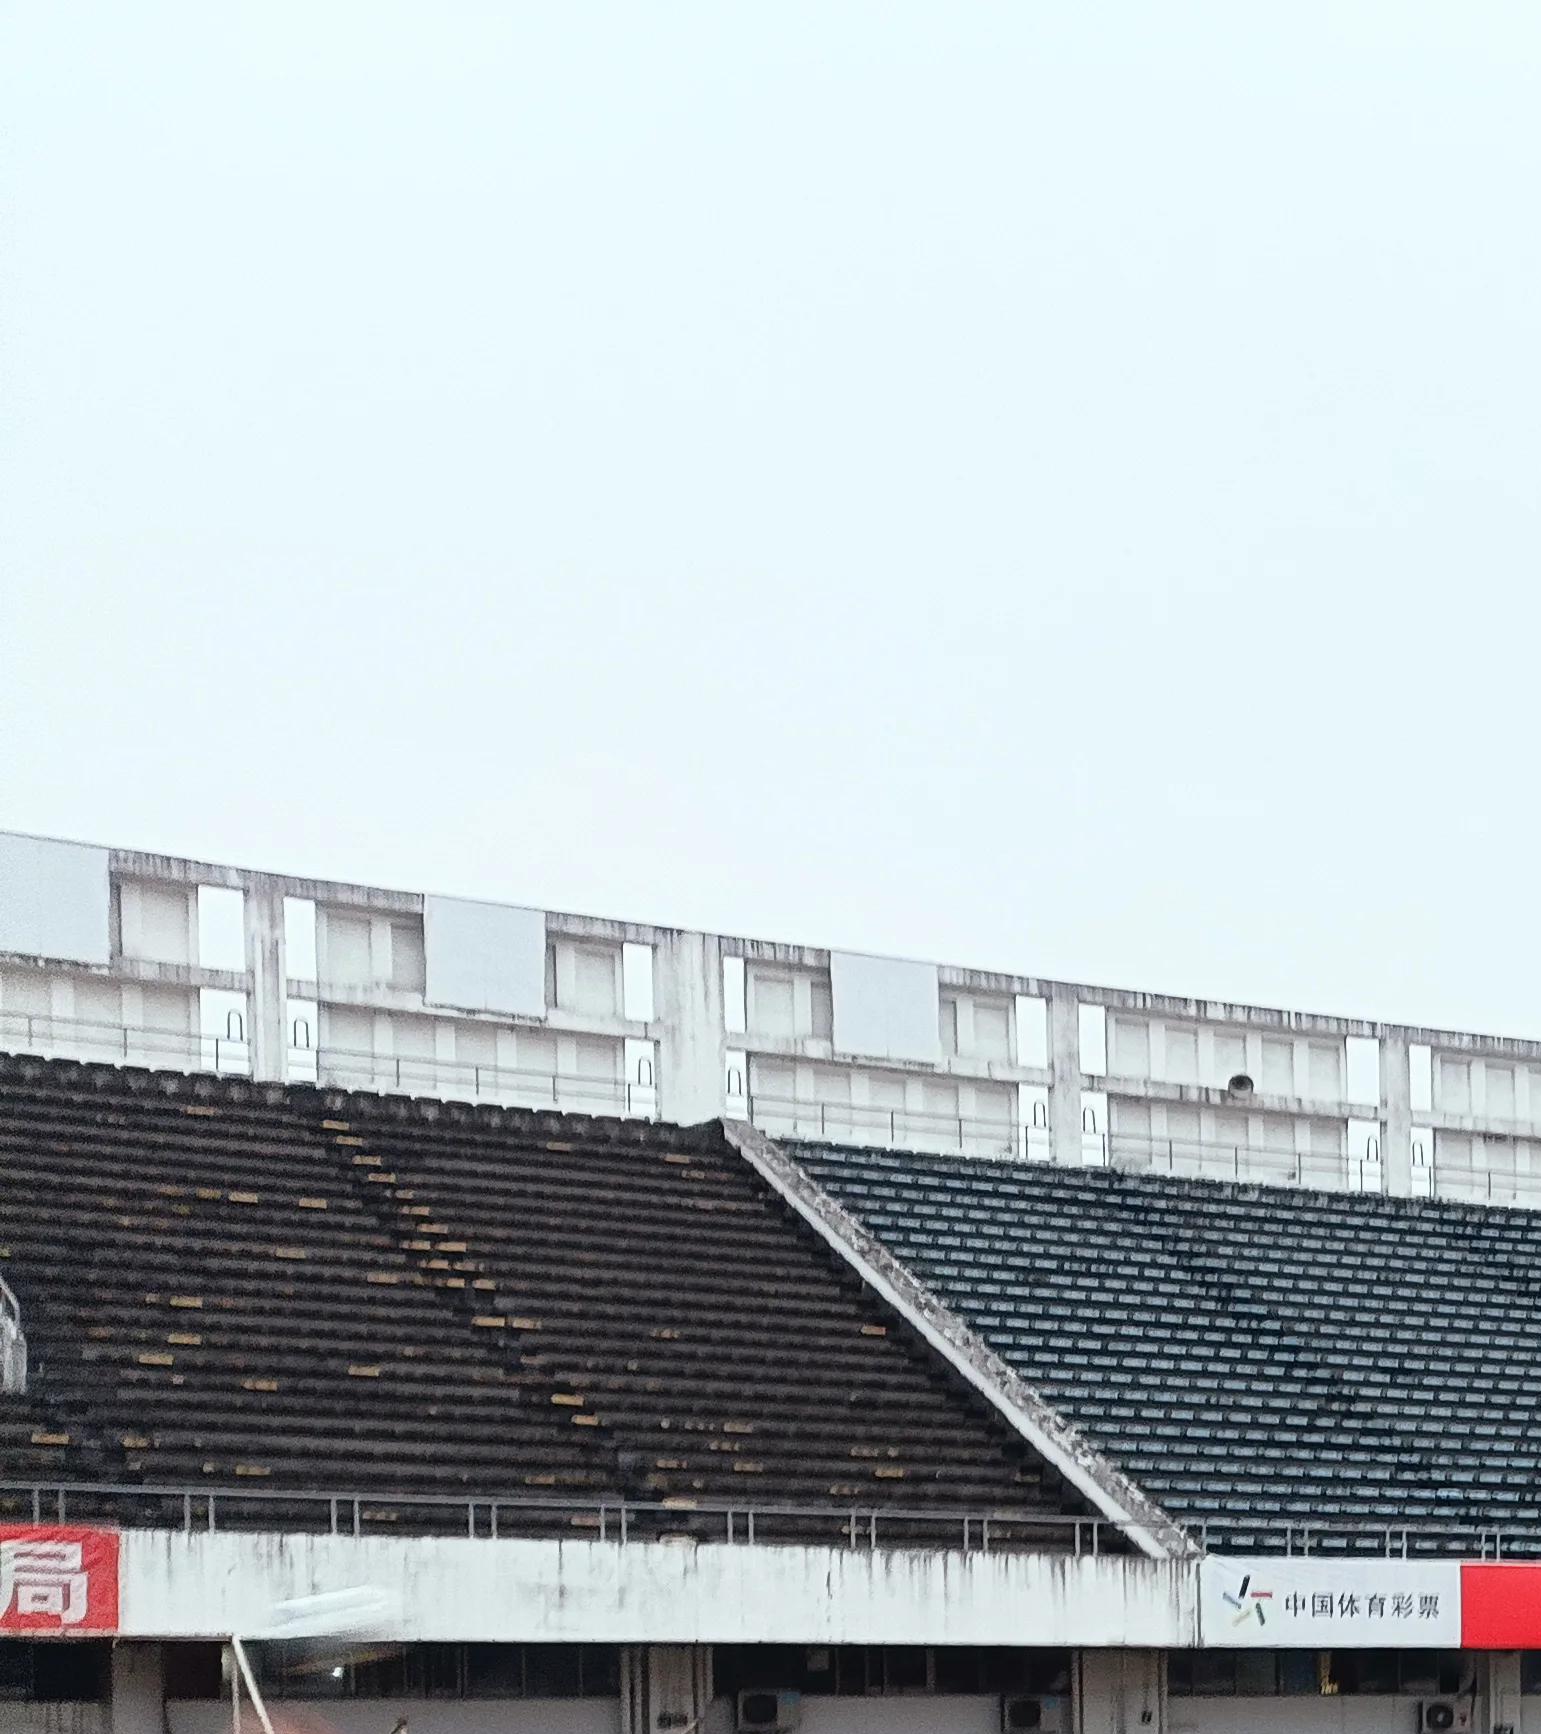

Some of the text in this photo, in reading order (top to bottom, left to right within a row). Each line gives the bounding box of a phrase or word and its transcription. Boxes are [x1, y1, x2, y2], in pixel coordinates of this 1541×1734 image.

[0, 1541, 89, 1625] 局
[1285, 1590, 1440, 1619] 中国体育彩票
